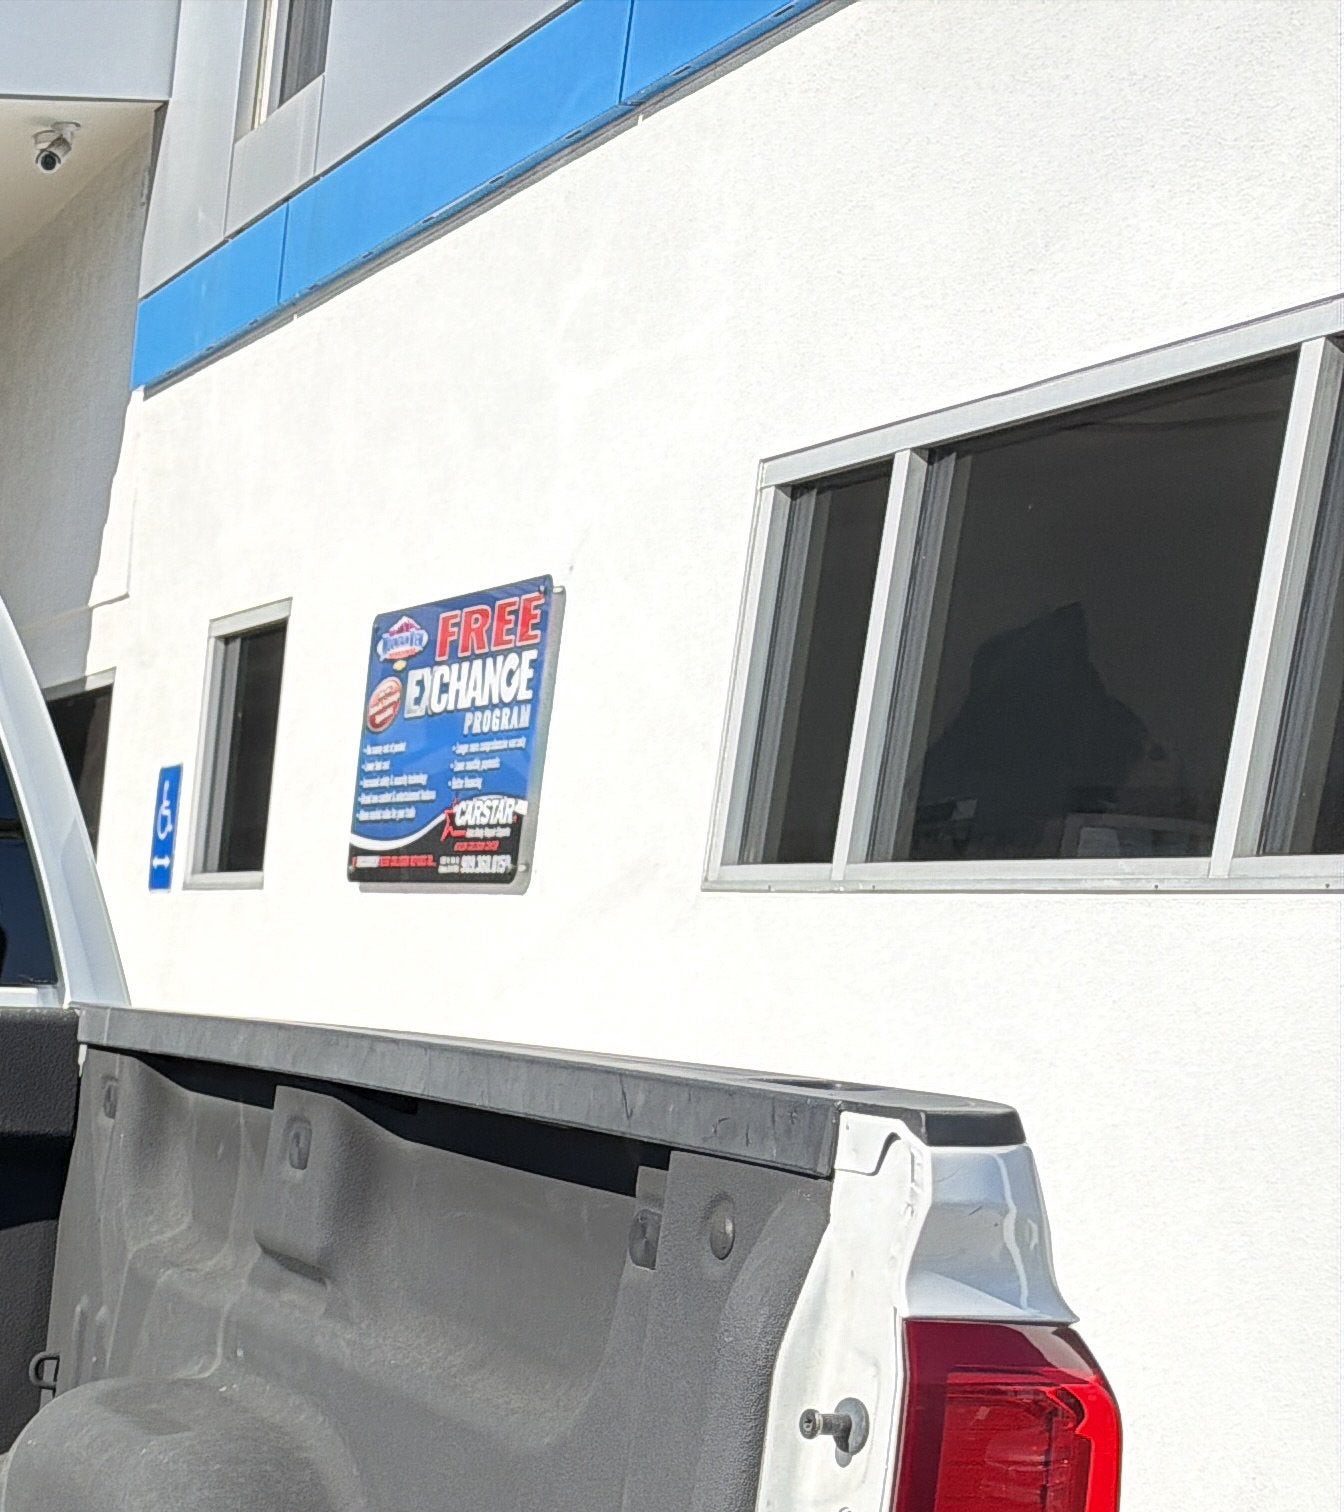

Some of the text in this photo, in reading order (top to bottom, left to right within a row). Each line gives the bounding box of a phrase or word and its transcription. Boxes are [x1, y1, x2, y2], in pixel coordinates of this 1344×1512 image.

[435, 591, 545, 662] FREE
[404, 649, 538, 719] EXCHANGE
[463, 704, 532, 736] PROGRAM
[454, 797, 516, 827] CARSTAR
